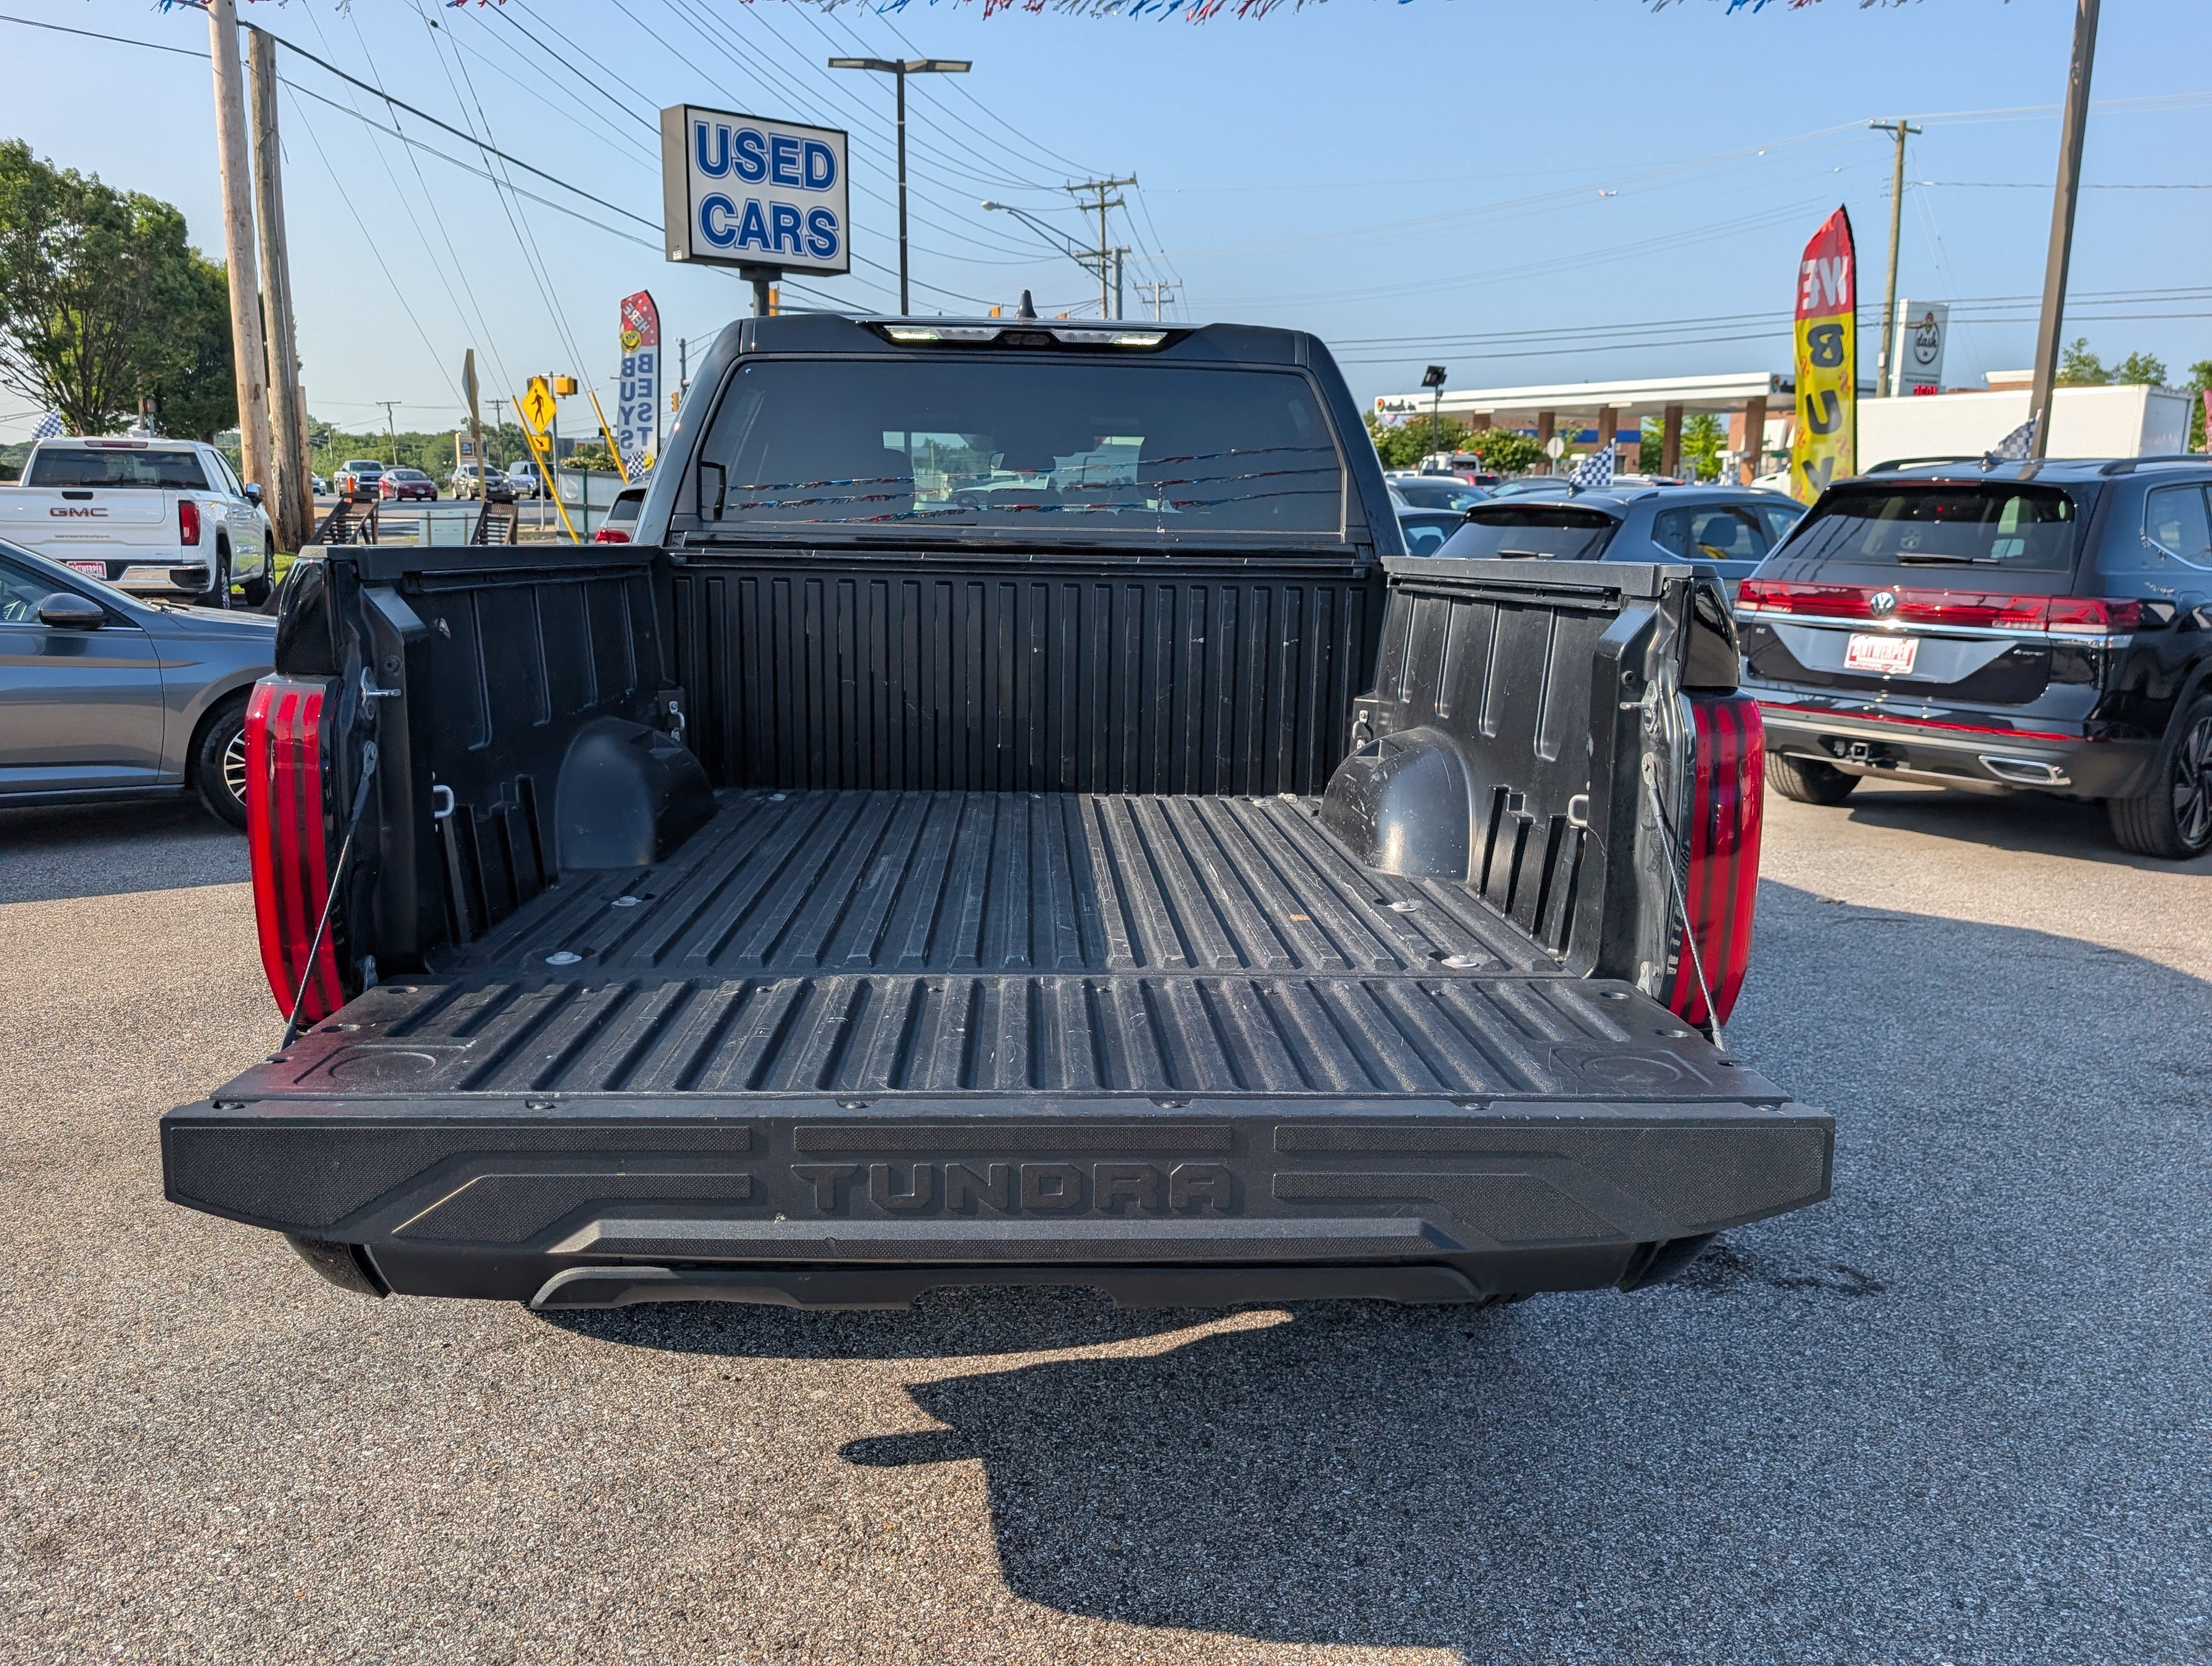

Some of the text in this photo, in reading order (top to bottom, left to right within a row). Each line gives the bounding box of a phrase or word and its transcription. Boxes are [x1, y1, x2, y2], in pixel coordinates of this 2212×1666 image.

[695, 120, 838, 191] USED
[698, 192, 840, 260] CARS
[49, 507, 108, 517] GMC
[789, 1163, 1233, 1209] TUNDRA
